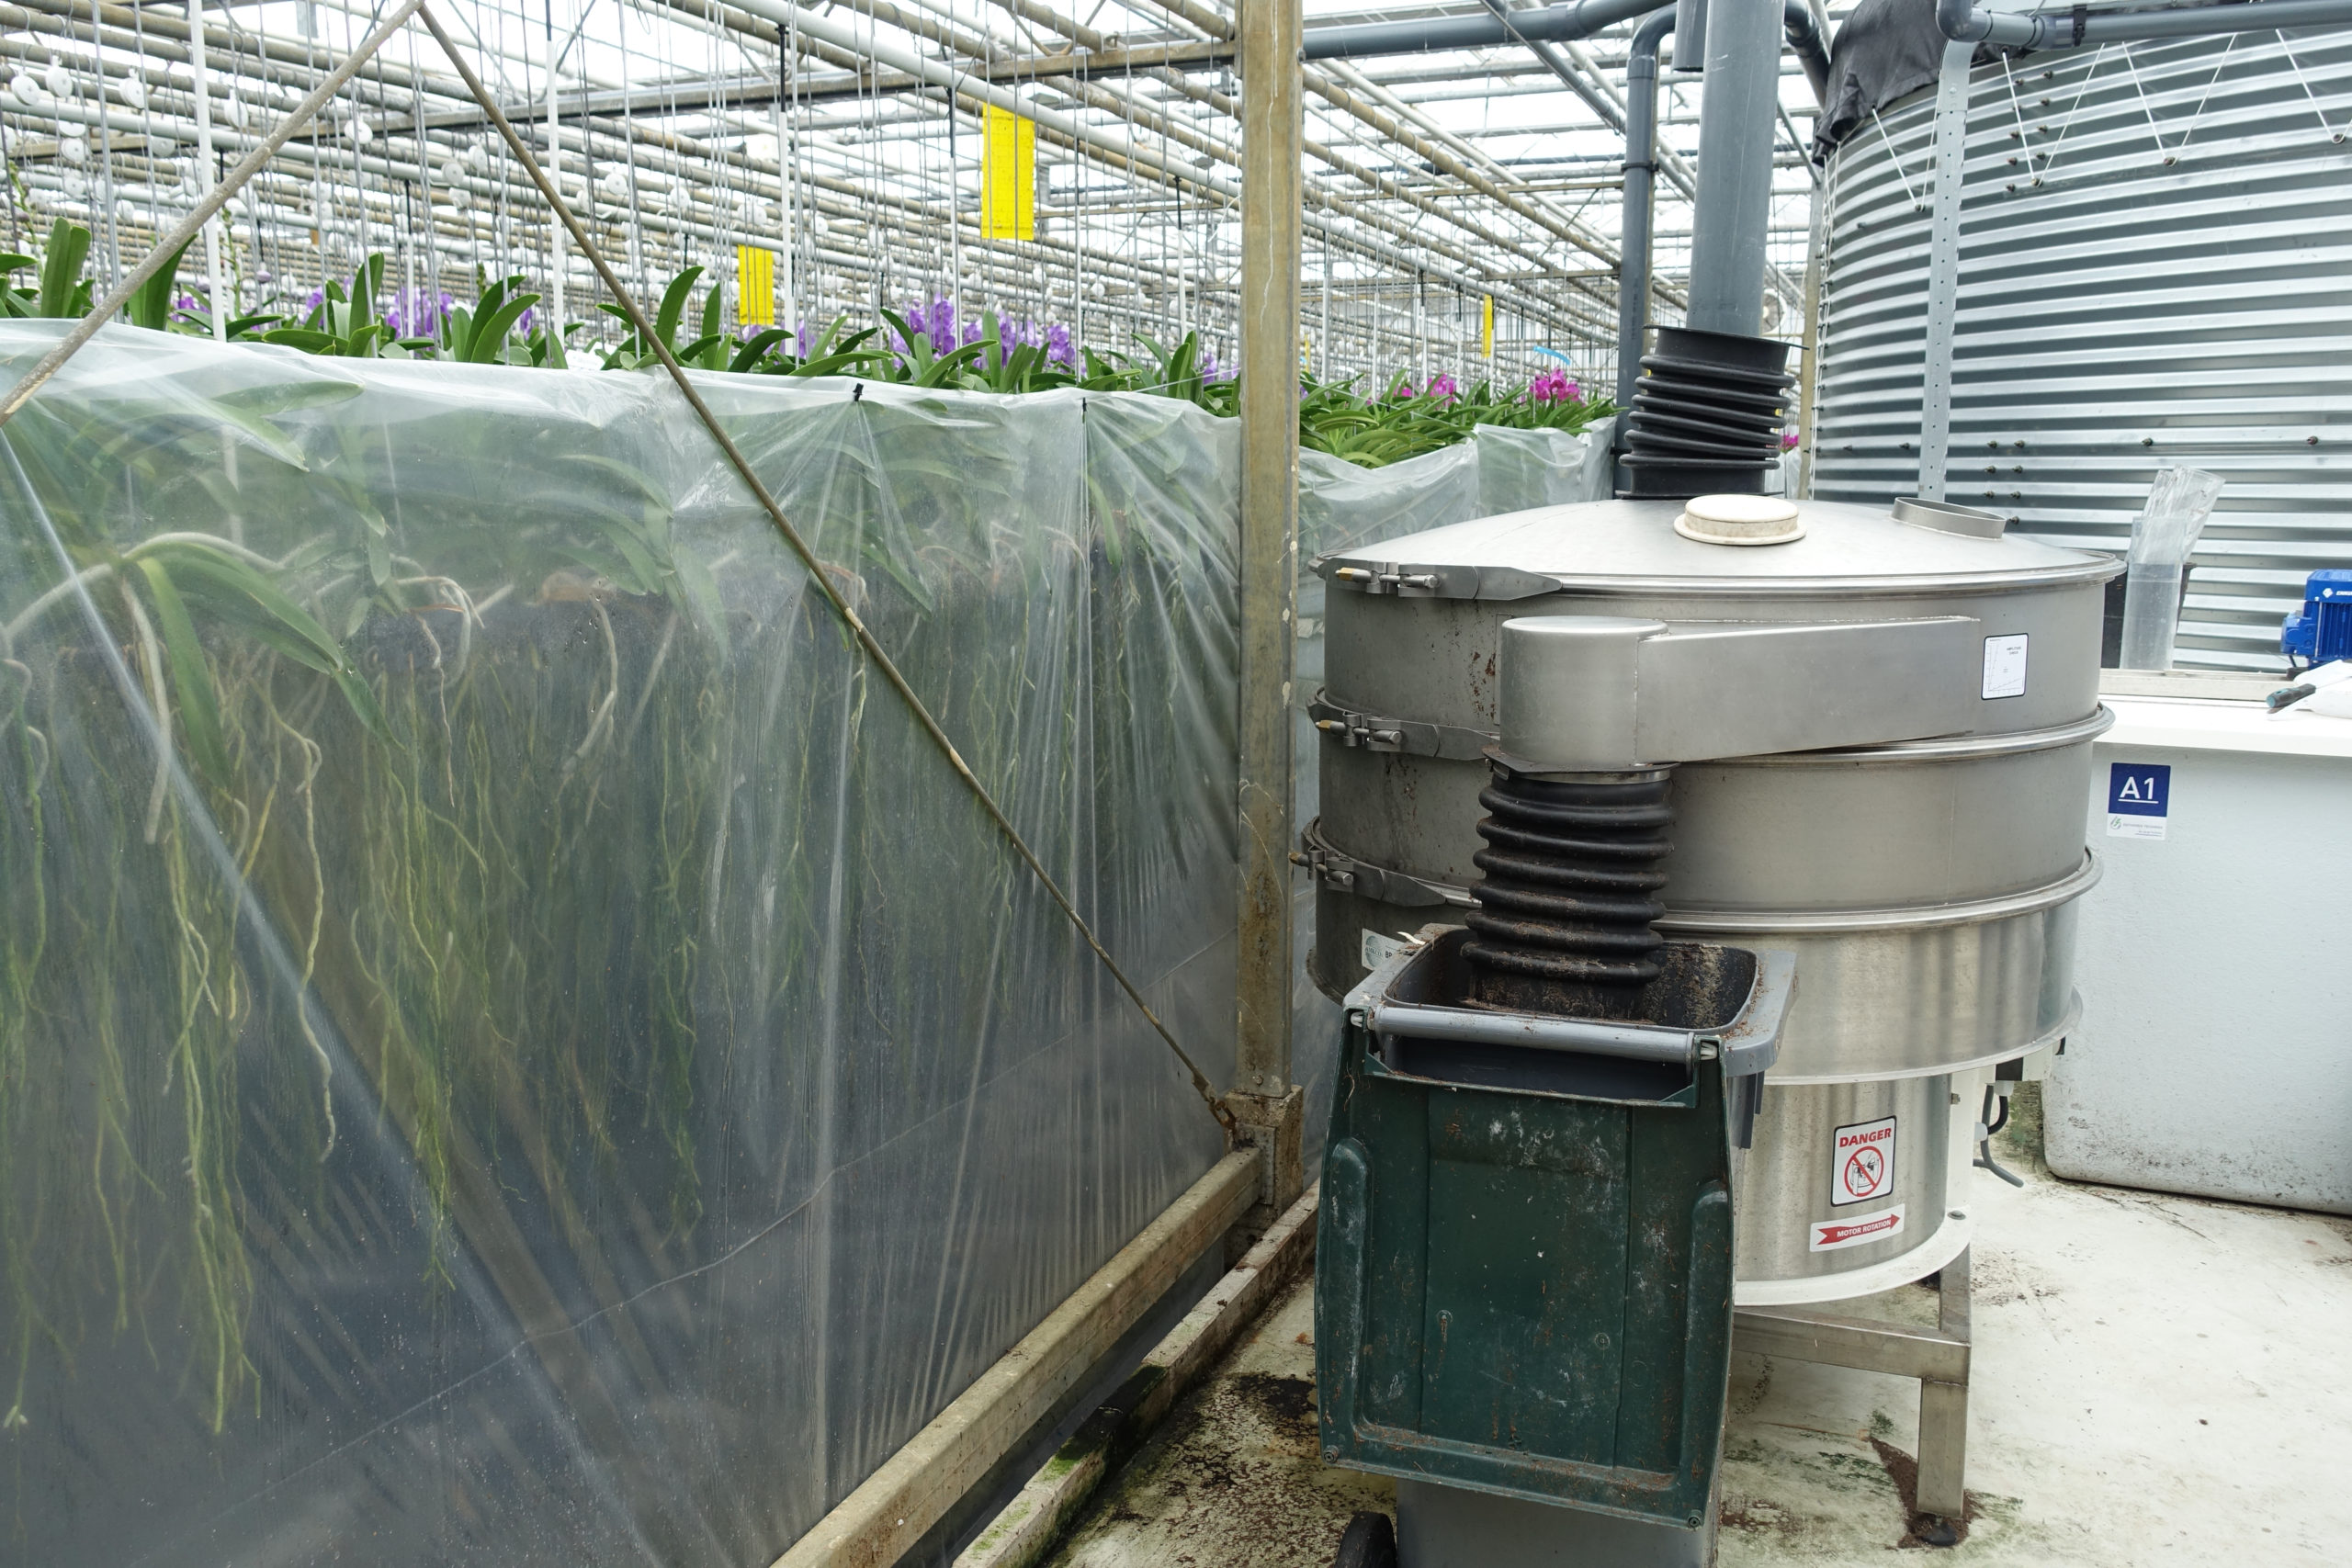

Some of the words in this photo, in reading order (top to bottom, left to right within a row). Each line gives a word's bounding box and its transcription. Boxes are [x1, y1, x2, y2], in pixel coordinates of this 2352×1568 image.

[2119, 776, 2154, 800] A1
[1839, 1128, 1892, 1147] DANGER
[1837, 1226, 1861, 1237] MOTOR
[1862, 1219, 1892, 1233] ROTATION
